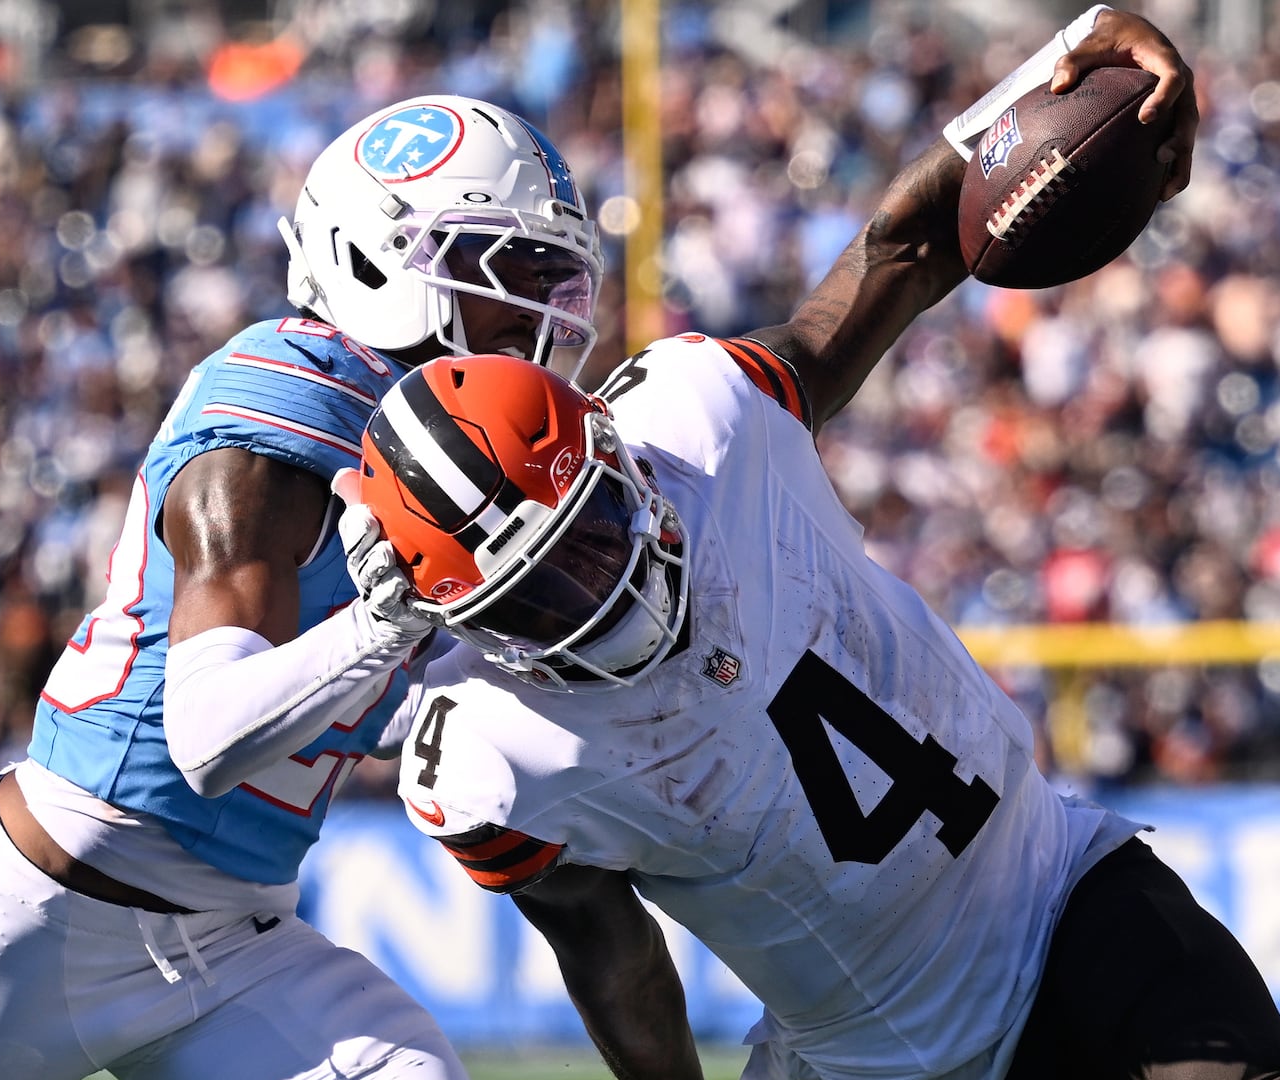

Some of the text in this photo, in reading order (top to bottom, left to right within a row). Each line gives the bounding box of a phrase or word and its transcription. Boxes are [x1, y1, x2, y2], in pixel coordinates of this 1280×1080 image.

[983, 113, 1012, 152] NFL
[558, 453, 583, 489] OAKLEY
[486, 516, 526, 556] BROWNS
[715, 659, 738, 683] NFL
[414, 694, 459, 790] 4
[765, 648, 1001, 865] 4
